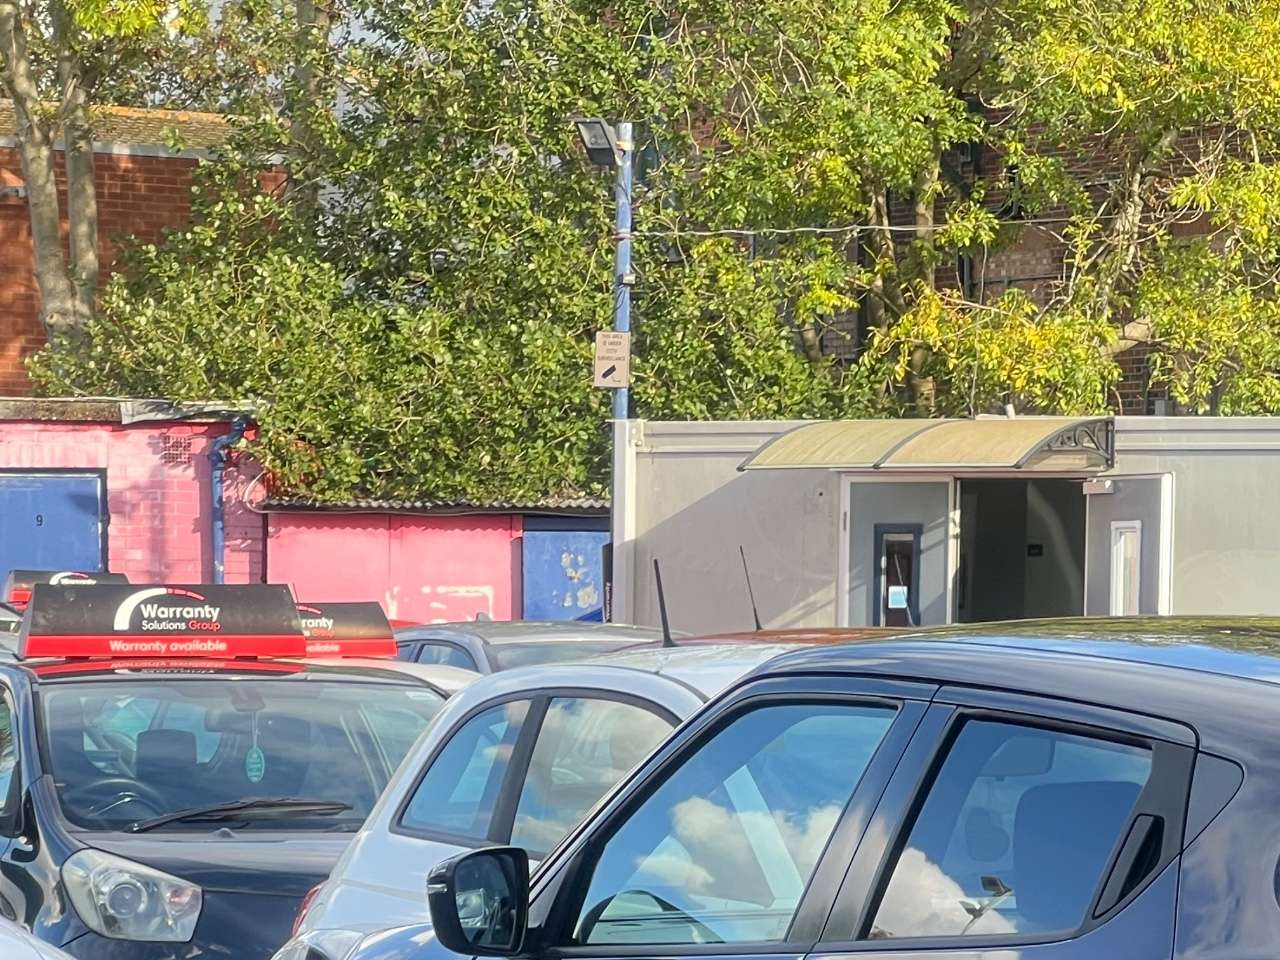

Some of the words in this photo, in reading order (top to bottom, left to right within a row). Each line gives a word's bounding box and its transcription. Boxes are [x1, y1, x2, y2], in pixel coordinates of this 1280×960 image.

[36, 514, 43, 526] 9
[140, 604, 220, 622] Warranty
[142, 620, 186, 630] Solutions
[188, 620, 221, 631] Group
[301, 617, 334, 631] ranty
[109, 640, 167, 653] Warranty
[170, 640, 228, 651] available
